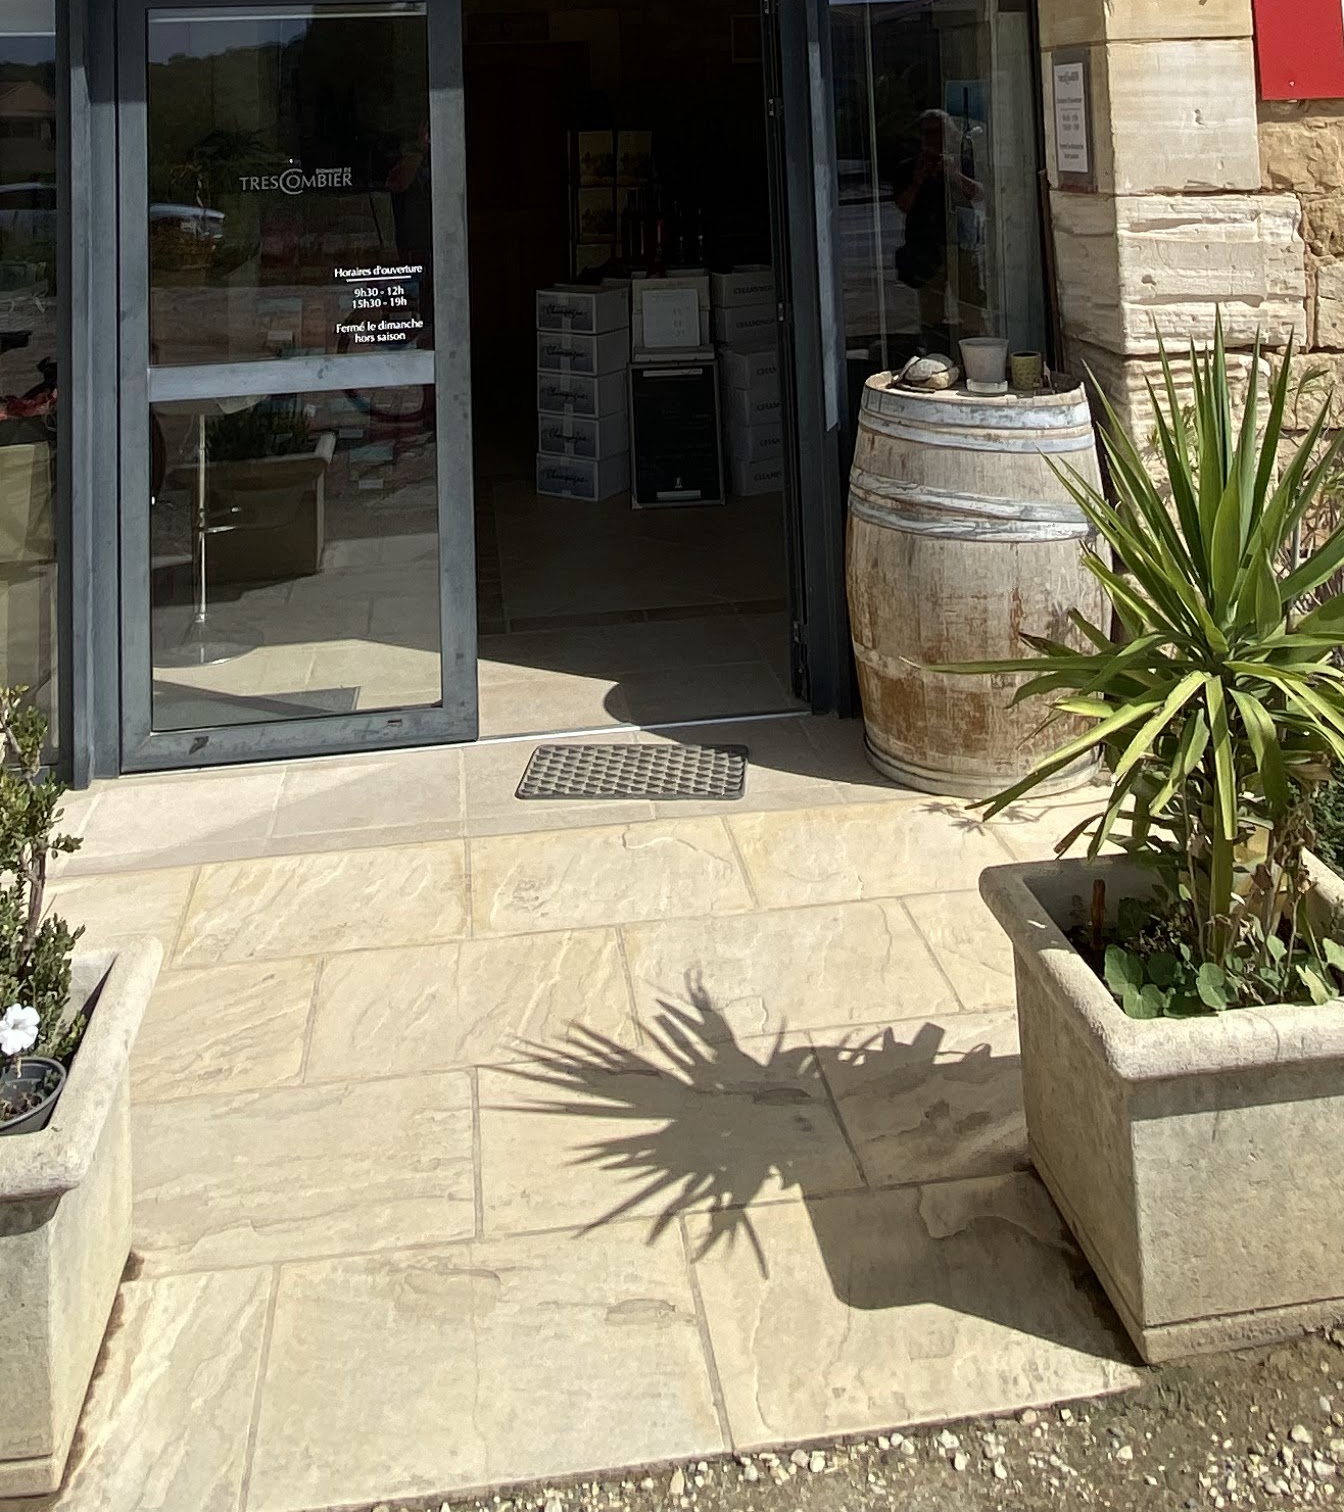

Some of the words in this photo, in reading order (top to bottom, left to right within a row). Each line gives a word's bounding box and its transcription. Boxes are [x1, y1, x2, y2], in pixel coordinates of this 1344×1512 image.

[239, 168, 353, 195] TRESCOMBIER
[334, 266, 371, 278] Horaires
[373, 264, 423, 276] d'ouverture
[387, 286, 404, 296] 12h
[390, 296, 407, 307] 19h
[336, 322, 365, 334] Fermé
[367, 321, 376, 332] le
[378, 319, 424, 331] dimanche
[354, 332, 375, 344] hors
[376, 331, 406, 343] saison
